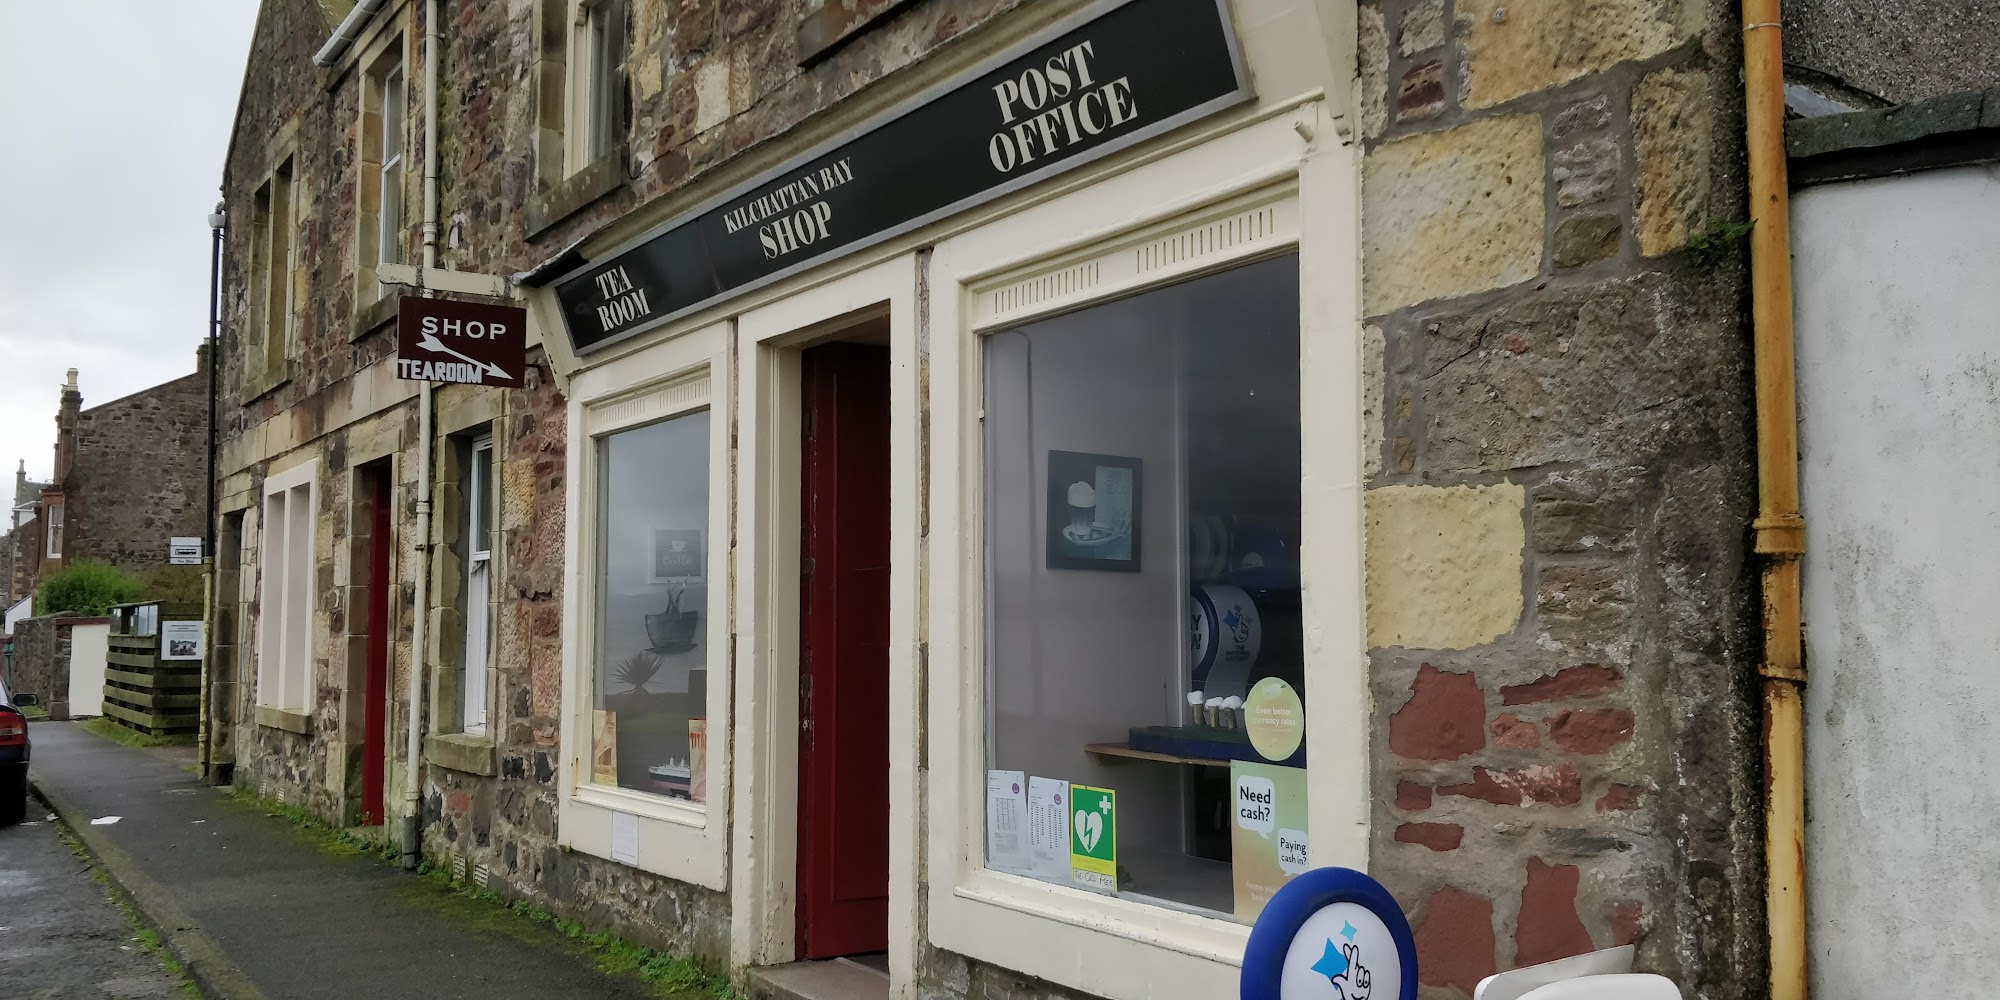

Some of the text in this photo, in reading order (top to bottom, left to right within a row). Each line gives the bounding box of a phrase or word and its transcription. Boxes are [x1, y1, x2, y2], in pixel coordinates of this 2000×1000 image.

[992, 40, 1095, 125] POST
[989, 76, 1138, 173] OFFICE
[723, 157, 855, 234] KILCHATTAN BAY
[759, 201, 832, 260] SHOP
[595, 265, 634, 300] TEA
[596, 288, 651, 332] ROOM
[421, 316, 507, 340] SHOP
[398, 358, 483, 384] TEAROOM
[1253, 717, 1280, 727] currency
[1256, 705, 1291, 716] Even better
[1240, 785, 1271, 804] Need
[1240, 806, 1271, 822] cash?
[1280, 837, 1307, 856] Paying
[1281, 853, 1307, 865] cash in?
